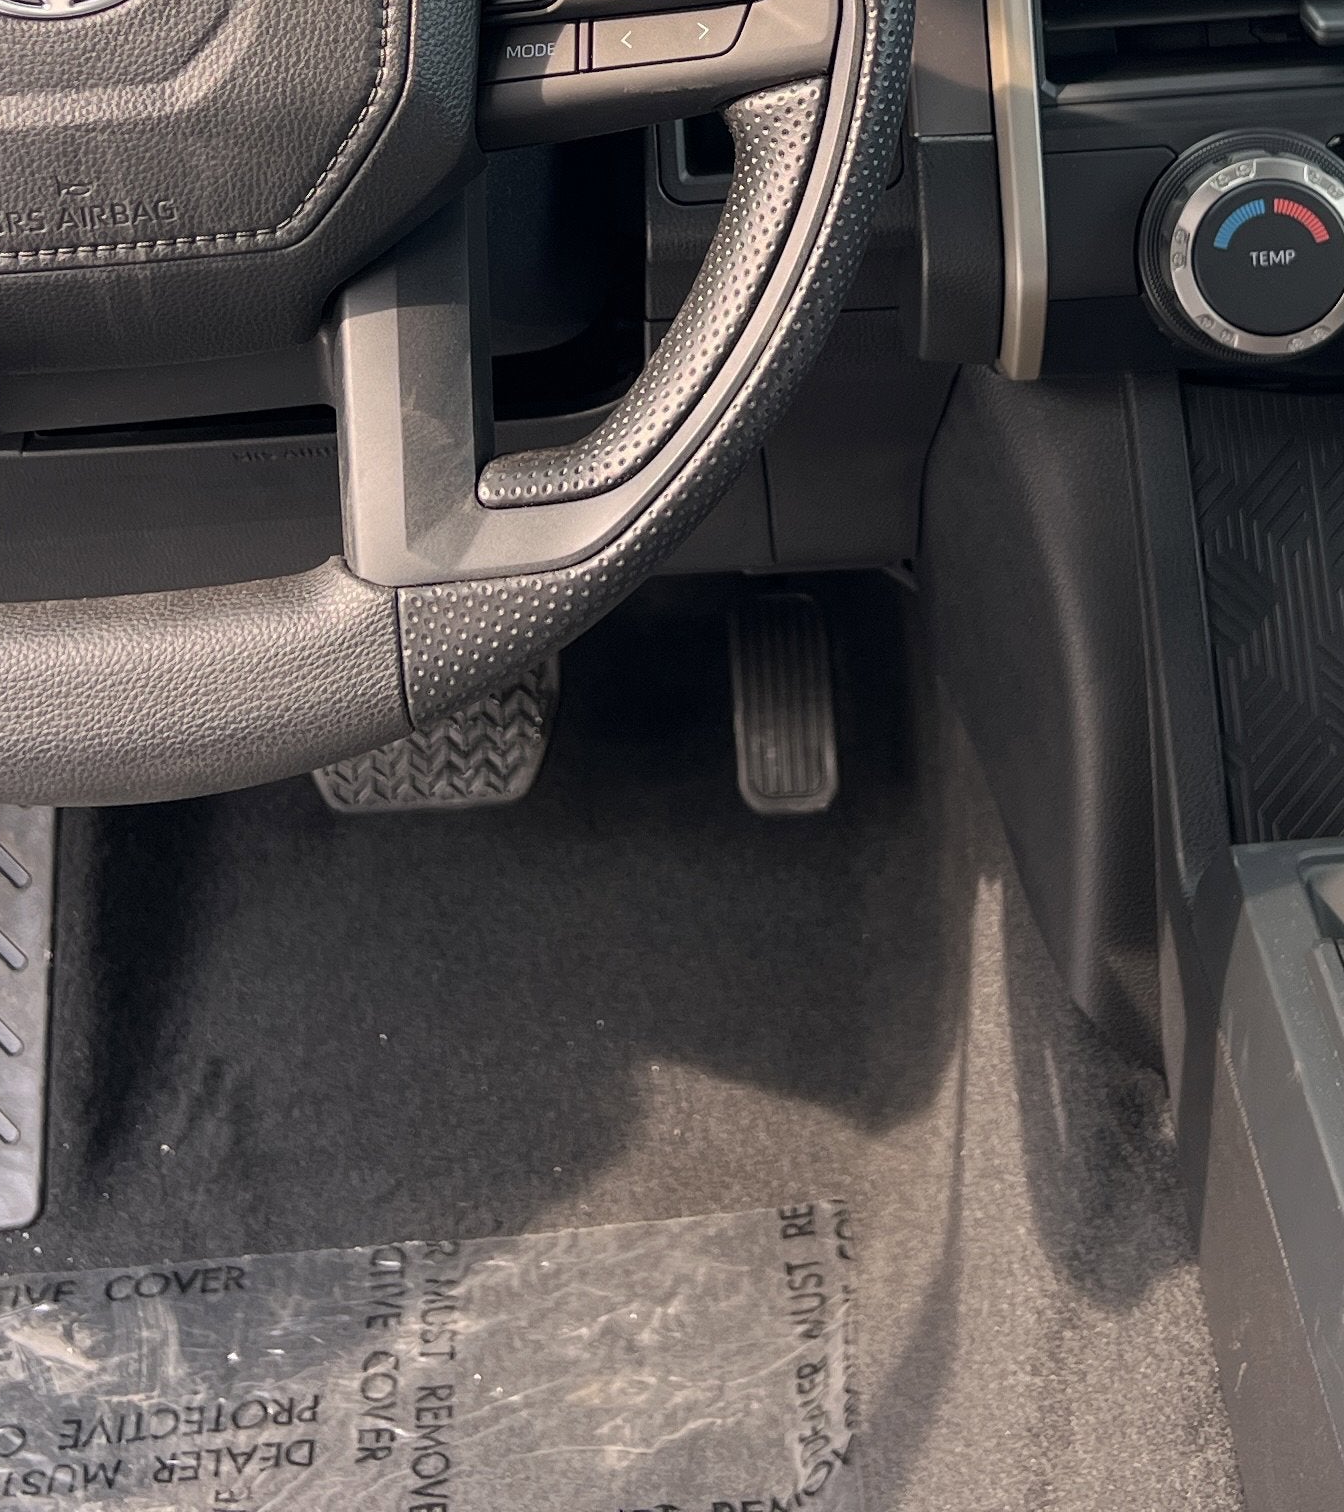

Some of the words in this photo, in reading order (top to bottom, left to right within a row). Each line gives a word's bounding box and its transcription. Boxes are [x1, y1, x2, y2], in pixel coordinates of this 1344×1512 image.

[506, 42, 556, 60] MODE
[55, 198, 180, 235] AIRBAG
[1249, 248, 1297, 268] TEMP
[105, 1265, 248, 1302] COVER
[58, 1394, 319, 1451] PROTECTIVE
[354, 1350, 400, 1464] COVER
[152, 1438, 315, 1484] DEALER
